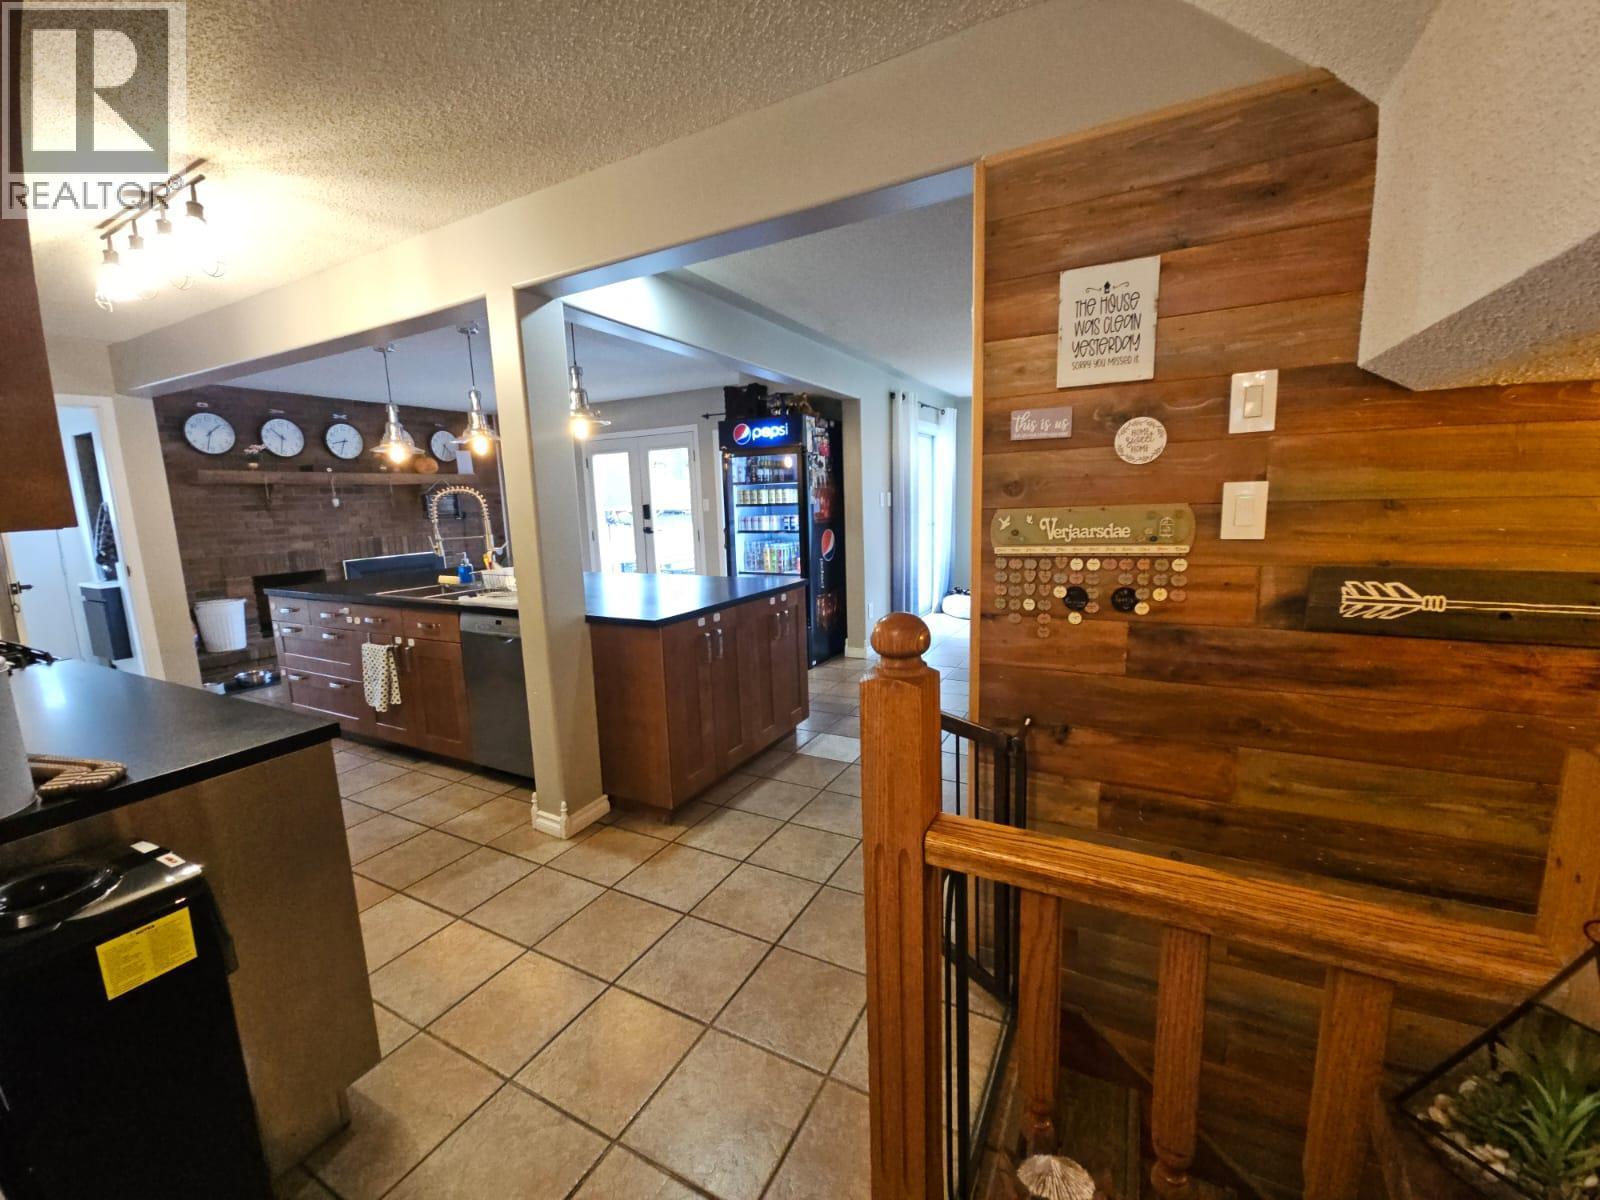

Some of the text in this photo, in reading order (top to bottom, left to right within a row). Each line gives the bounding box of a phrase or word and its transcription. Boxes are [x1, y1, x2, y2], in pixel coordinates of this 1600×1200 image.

[752, 422, 789, 441] pepsi
[1012, 411, 1069, 433] this is us
[1039, 517, 1131, 543] Verjaarsdae
